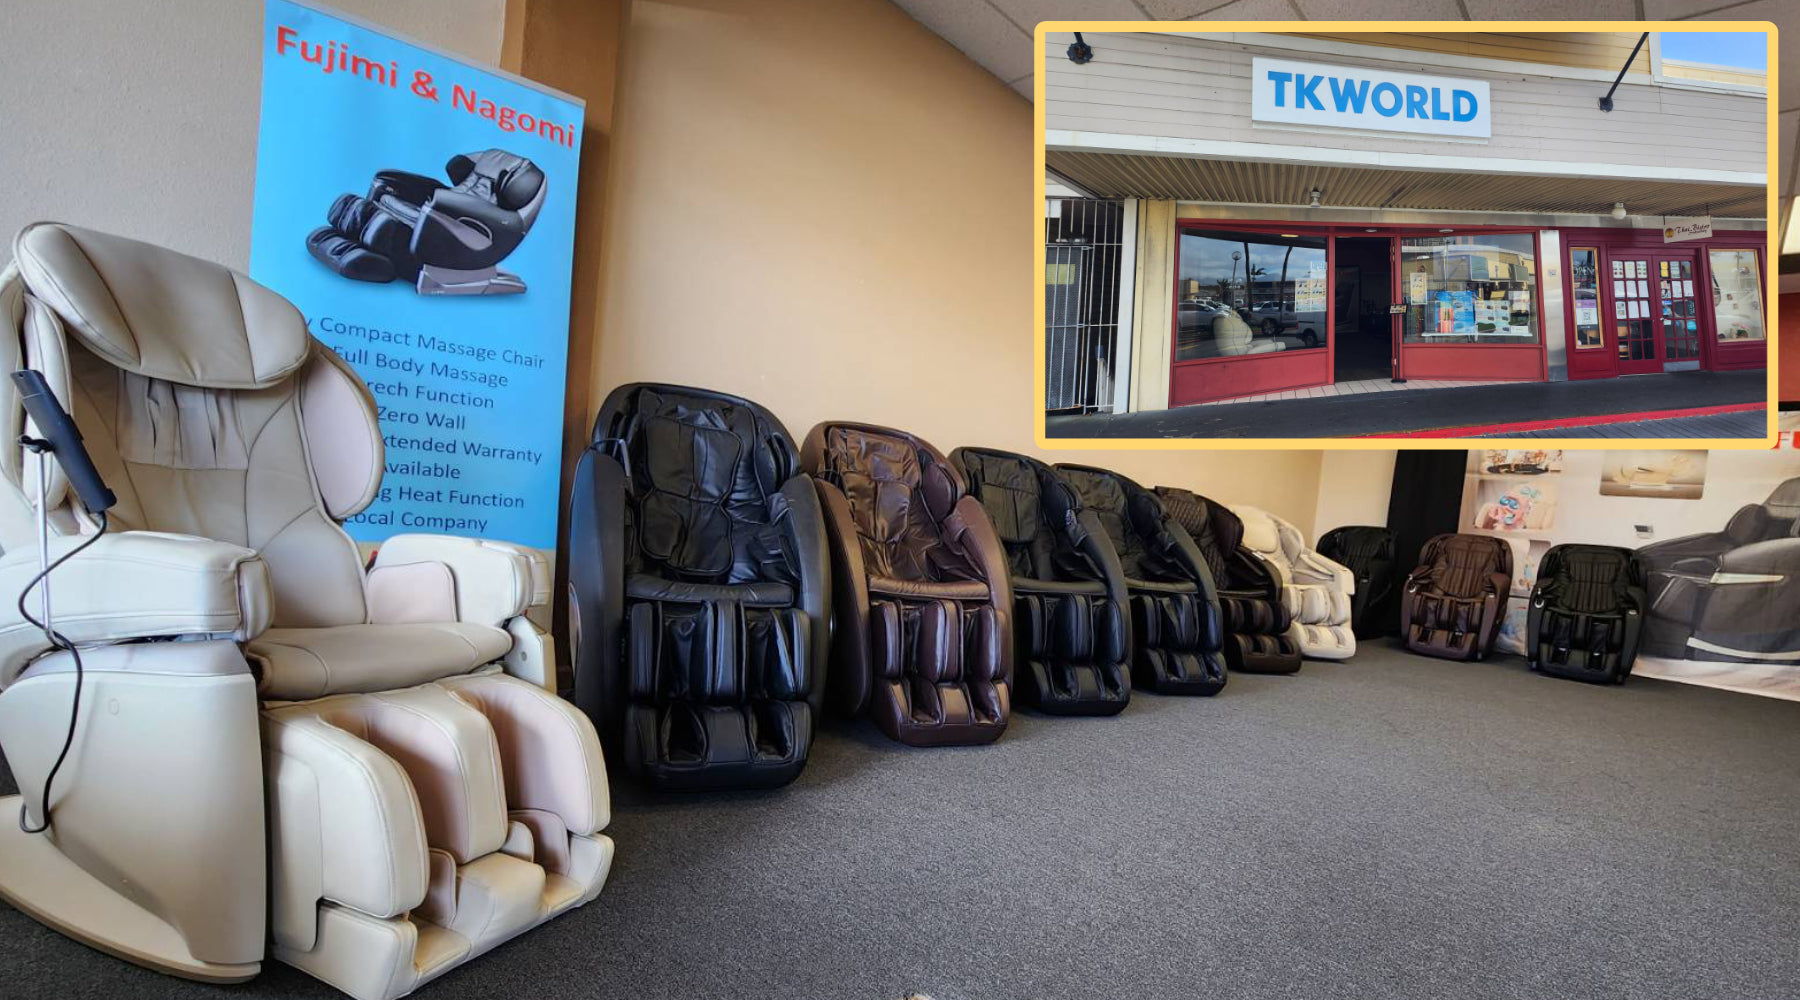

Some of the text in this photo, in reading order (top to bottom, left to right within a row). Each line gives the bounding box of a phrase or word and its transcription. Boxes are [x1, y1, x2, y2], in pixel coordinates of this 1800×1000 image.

[276, 26, 575, 148] Fujimi & Nagomi
[1268, 70, 1478, 122] TKWORLD
[320, 317, 546, 369] Compact Massage Chair
[376, 354, 424, 376] Body
[431, 362, 509, 388] Massage
[367, 381, 494, 409] rech Function
[378, 406, 466, 430] Zero Wall
[383, 435, 543, 466] xtended Warranty
[399, 486, 443, 503] Heat
[449, 490, 525, 509] Function
[401, 512, 488, 533] Company
